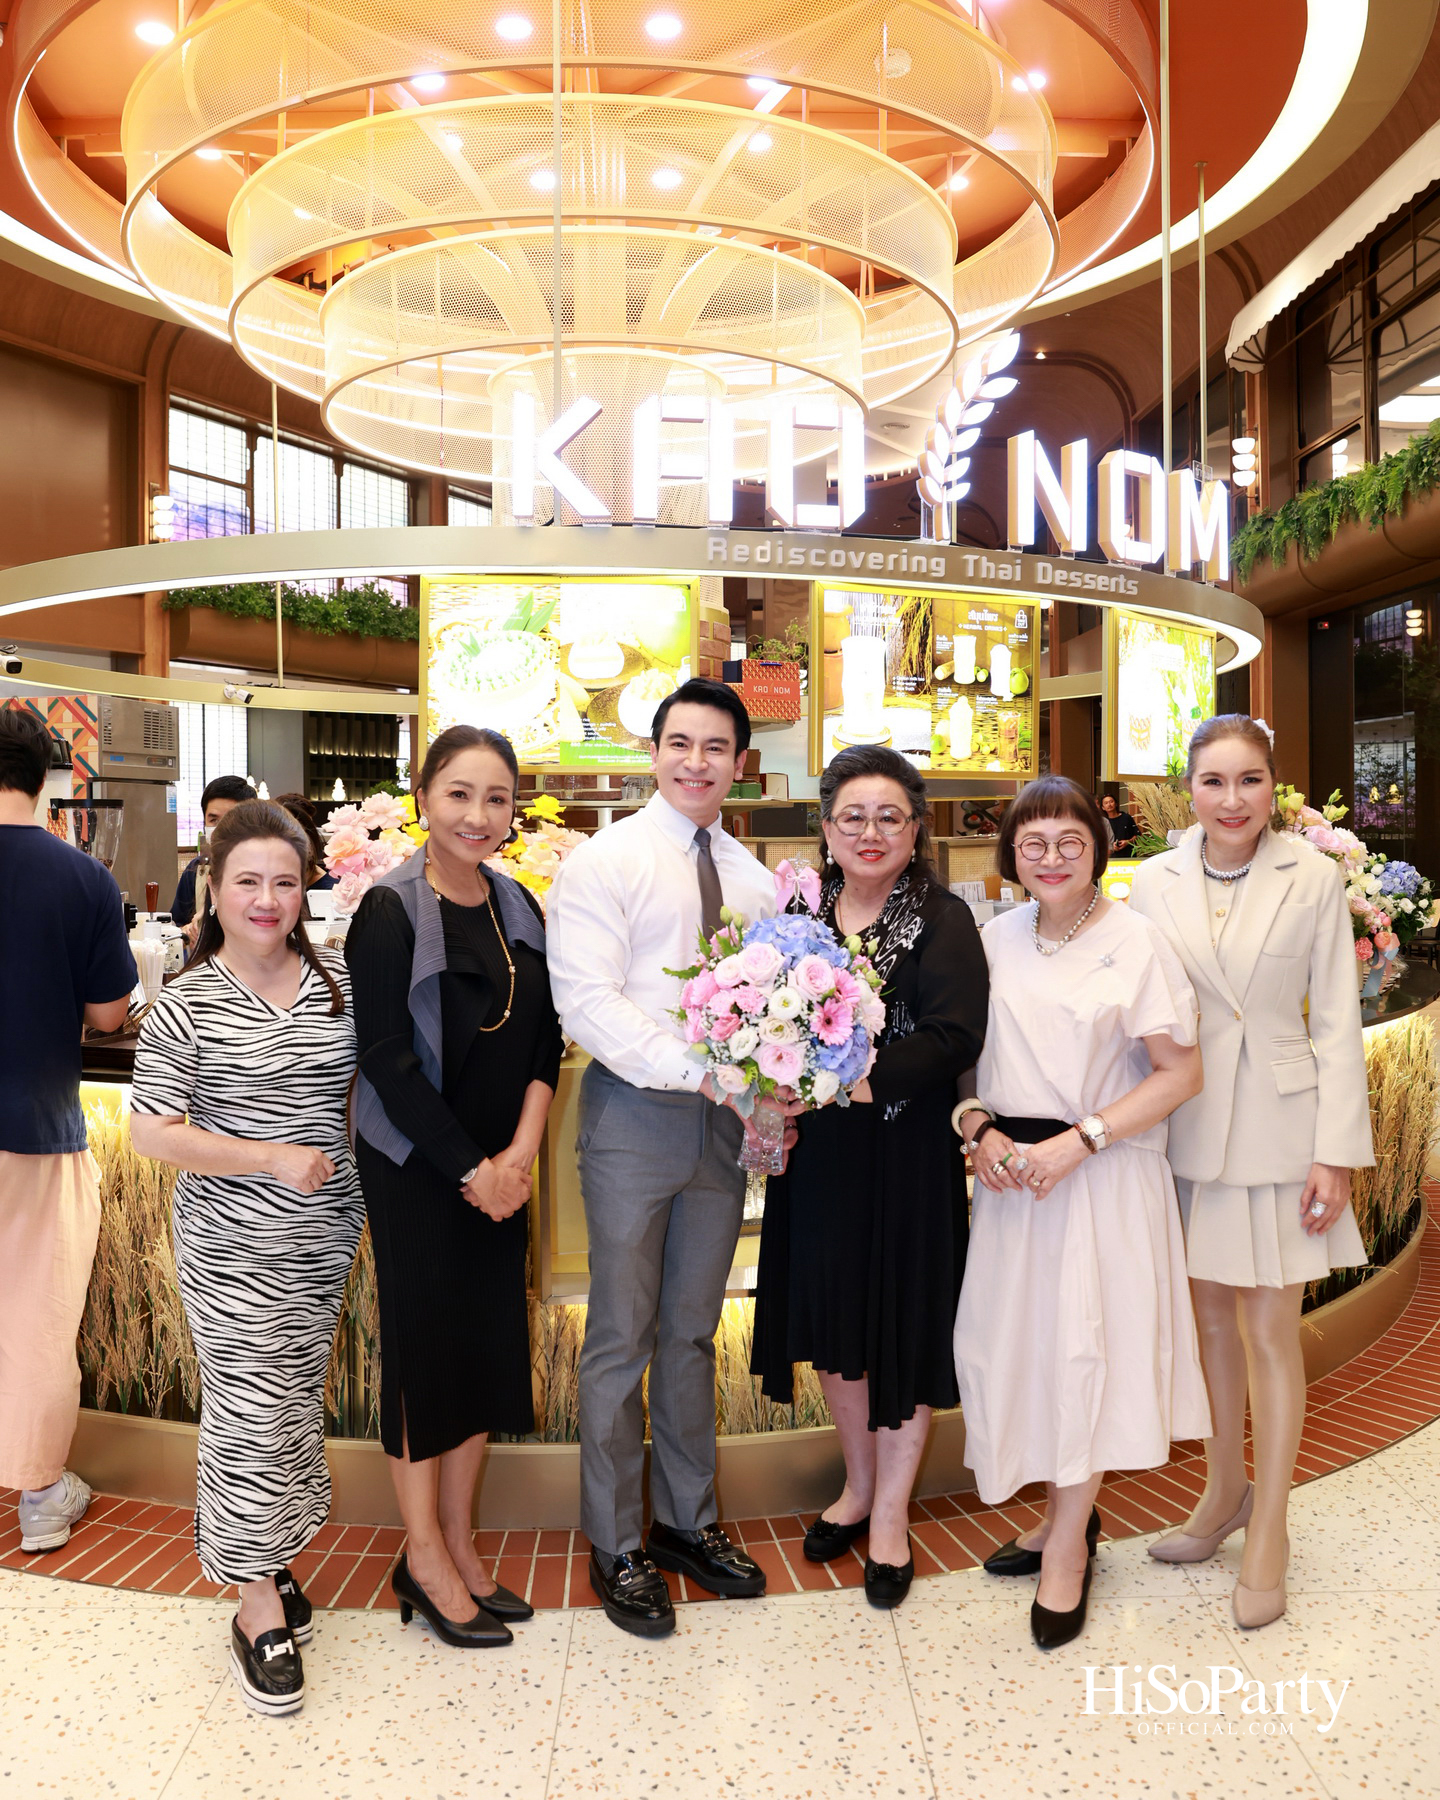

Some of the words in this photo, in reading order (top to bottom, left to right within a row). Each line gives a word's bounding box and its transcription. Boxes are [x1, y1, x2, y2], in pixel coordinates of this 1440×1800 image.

[512, 390, 866, 529] KAO
[1007, 429, 1230, 582] NOM
[706, 537, 947, 578] Rediscovering
[961, 553, 1022, 582] Thai
[1036, 561, 1139, 596] Desserts
[753, 685, 769, 694] KAO
[773, 686, 791, 695] NOM
